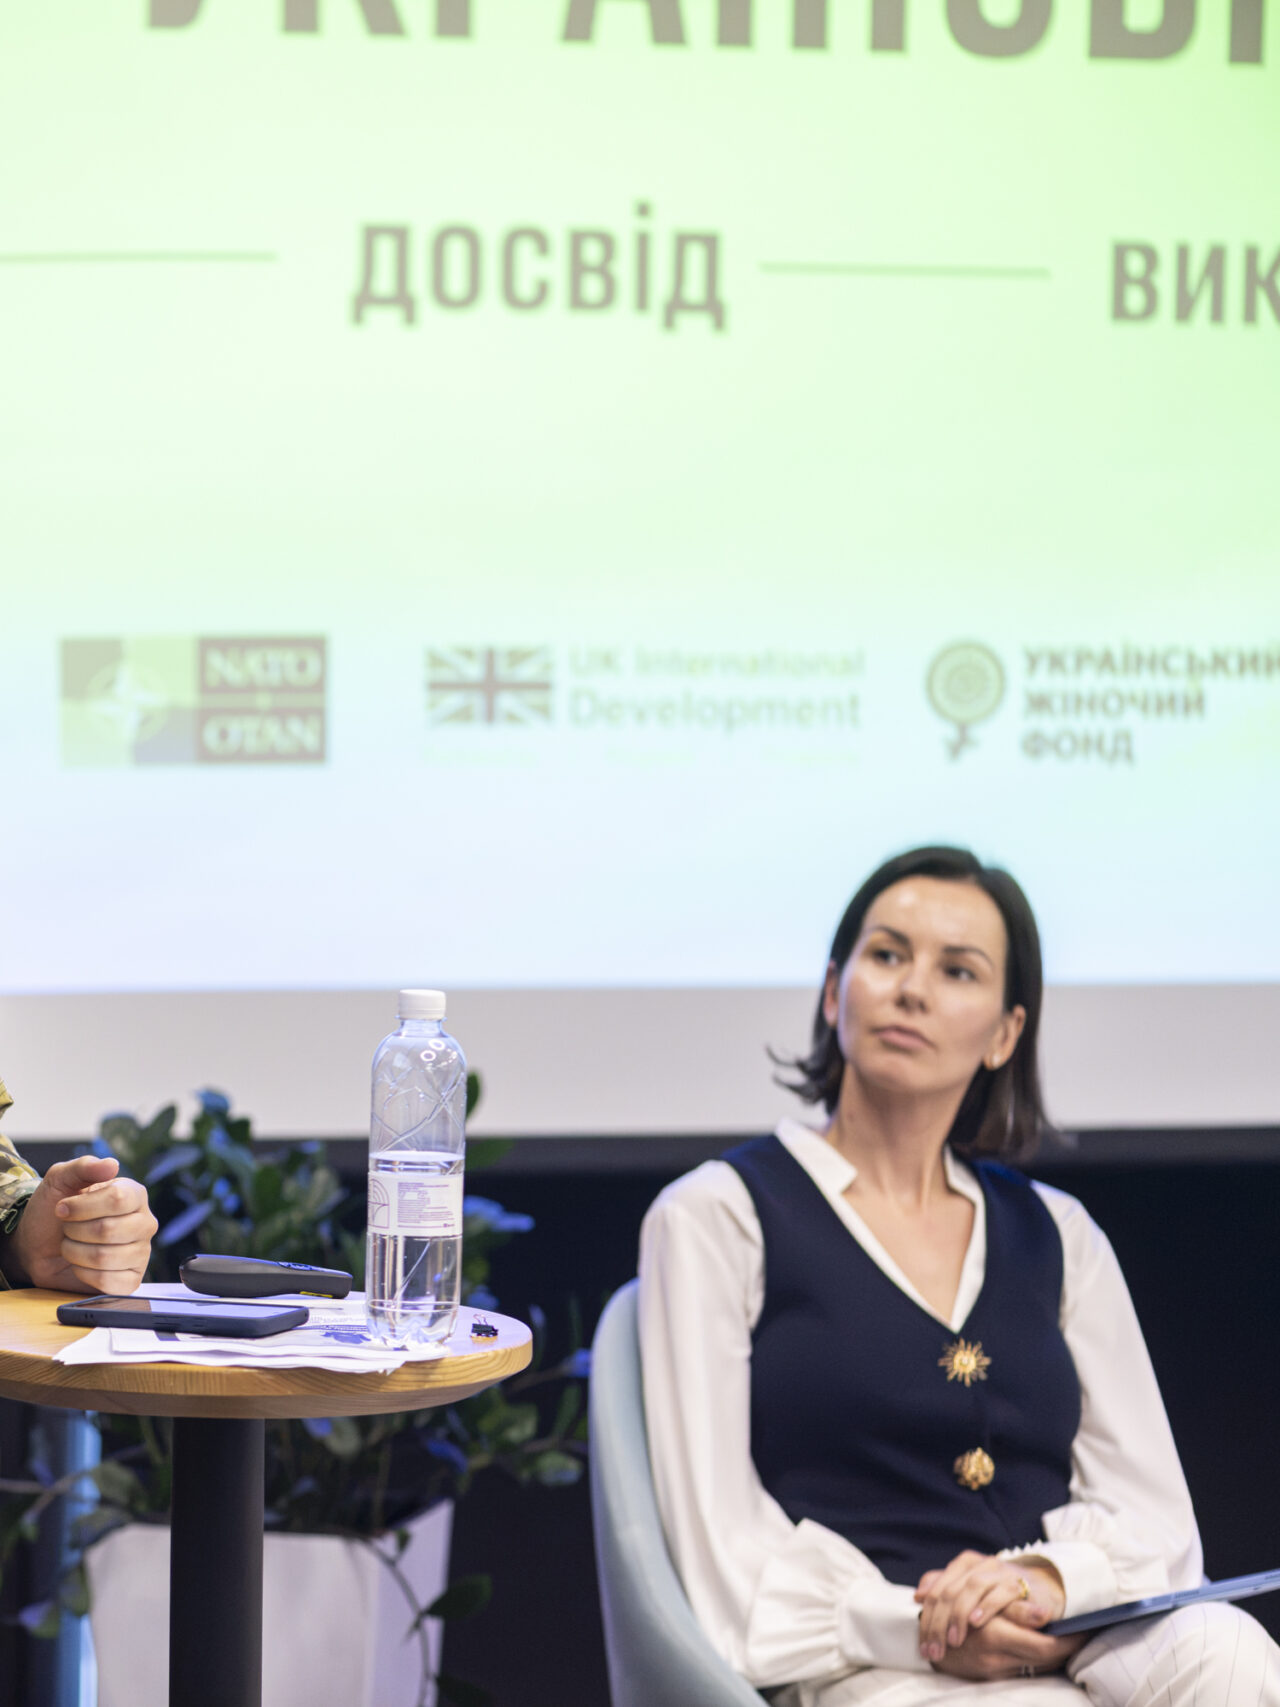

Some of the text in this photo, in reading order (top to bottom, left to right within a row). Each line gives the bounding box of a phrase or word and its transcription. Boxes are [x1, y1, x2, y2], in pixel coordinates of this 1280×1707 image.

[204, 648, 322, 688] NATO
[569, 646, 865, 677] UK International
[570, 688, 861, 735] Development
[202, 714, 322, 754] OTAN
[1022, 729, 1137, 766] ФОНД
